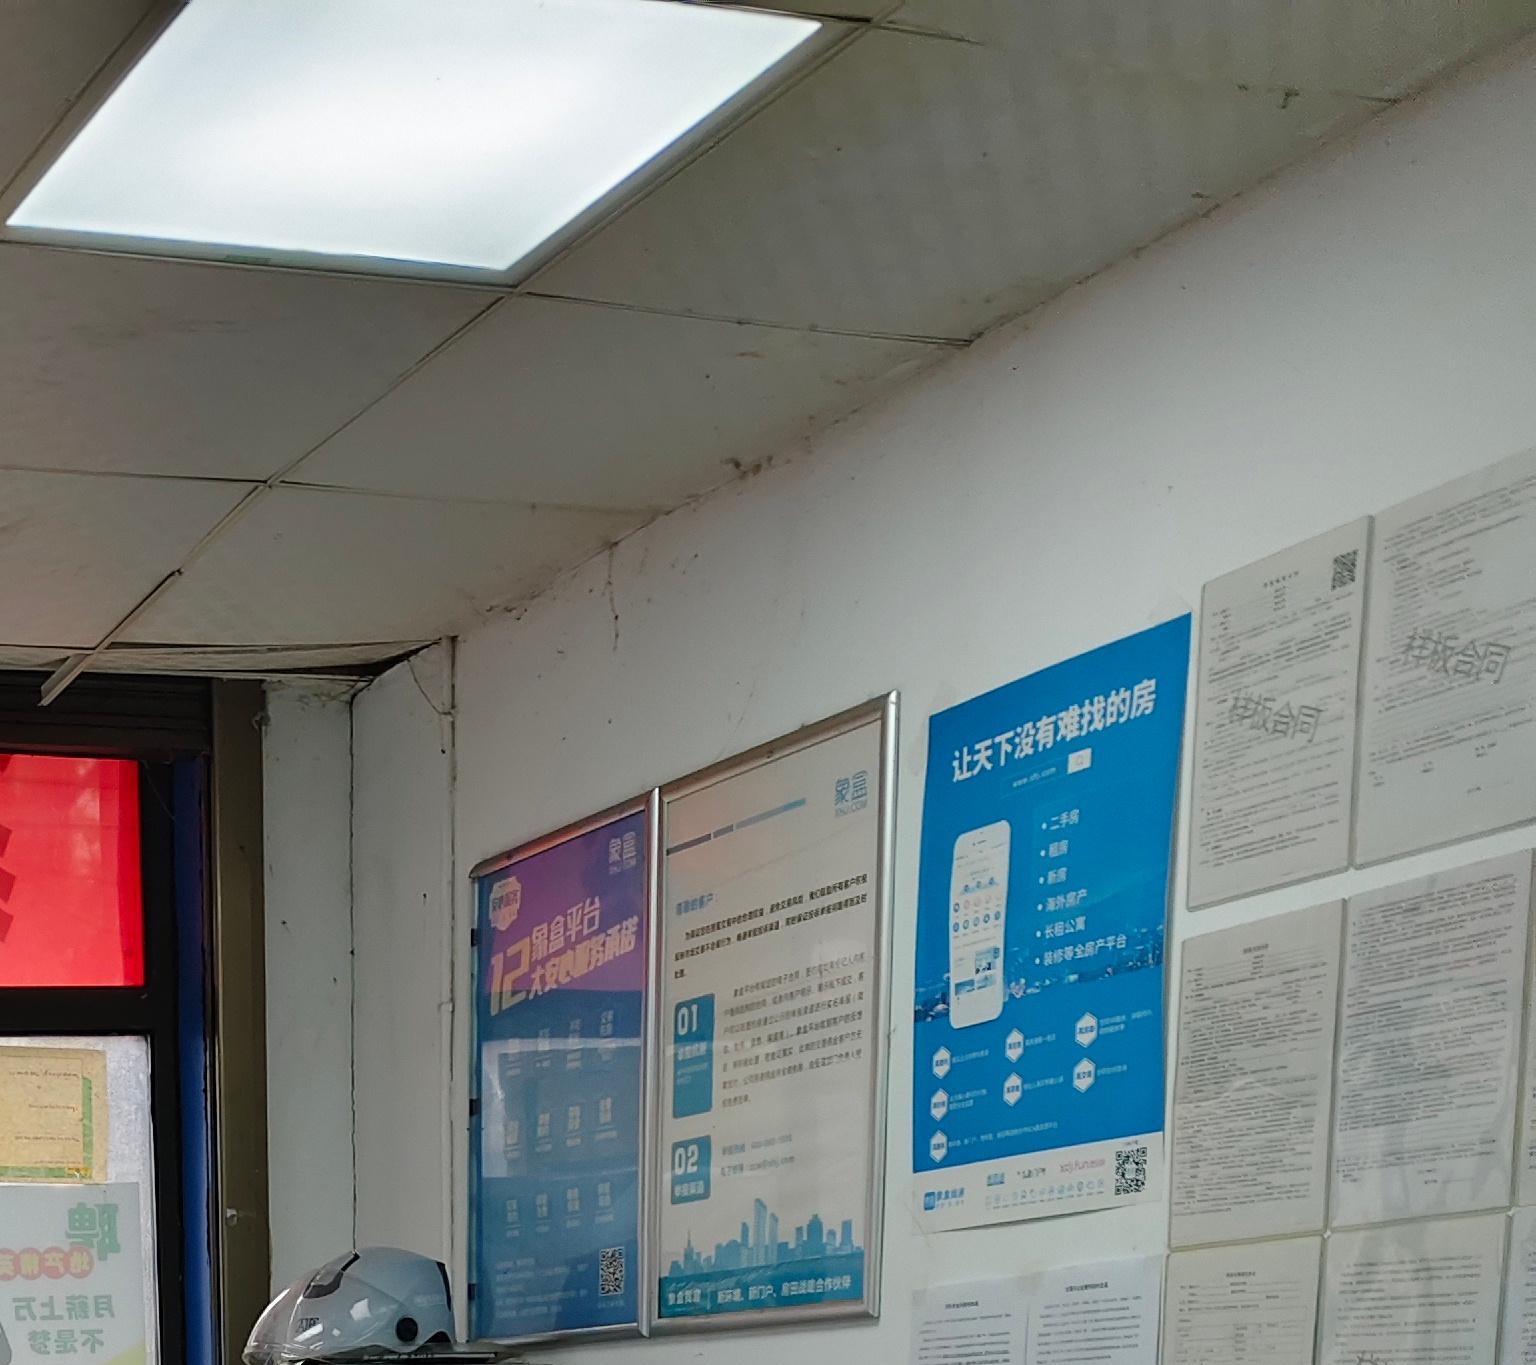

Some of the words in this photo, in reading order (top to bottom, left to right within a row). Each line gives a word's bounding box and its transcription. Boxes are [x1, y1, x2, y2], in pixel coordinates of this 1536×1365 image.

[1404, 629, 1511, 685] 样板合同
[952, 677, 1157, 783] 让天下没有难找的房
[1228, 687, 1324, 743] 样板合同
[1049, 809, 1080, 830] 二手房
[531, 896, 600, 961] 象盒平台
[1045, 916, 1086, 938] 长租公寓
[490, 936, 531, 1017] 12
[677, 1004, 698, 1036] 01
[675, 1144, 698, 1175] 02
